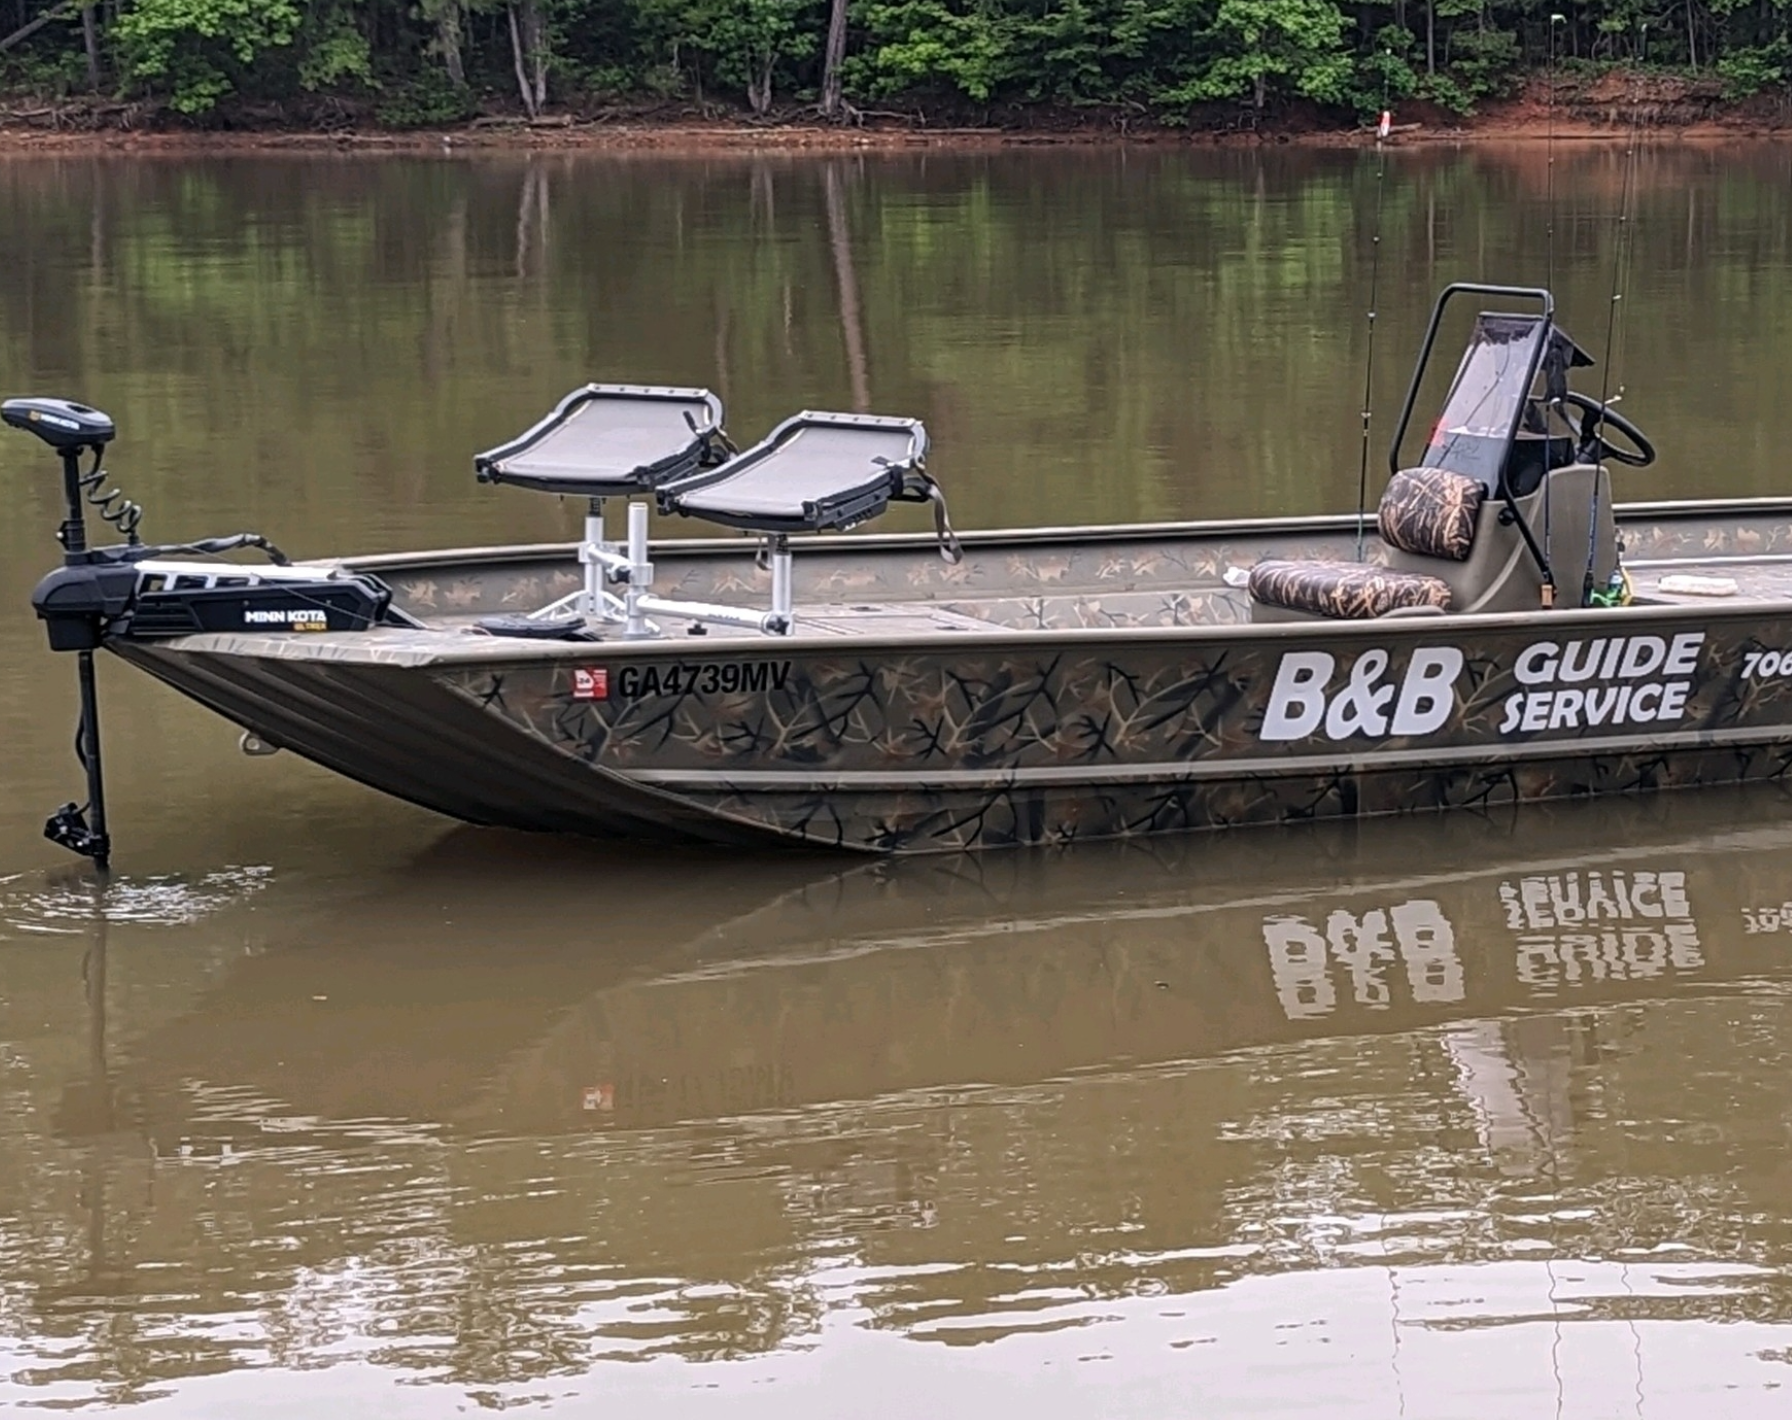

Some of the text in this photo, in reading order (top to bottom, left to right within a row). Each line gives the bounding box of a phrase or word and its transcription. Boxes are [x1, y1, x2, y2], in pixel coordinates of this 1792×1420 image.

[245, 610, 327, 622] MINN KOTA
[618, 661, 791, 698] GA4739MV
[1514, 633, 1705, 685] GUIDE
[1740, 651, 1792, 679] 706
[1260, 647, 1464, 741] B&B
[1500, 682, 1691, 734] SERVICE
